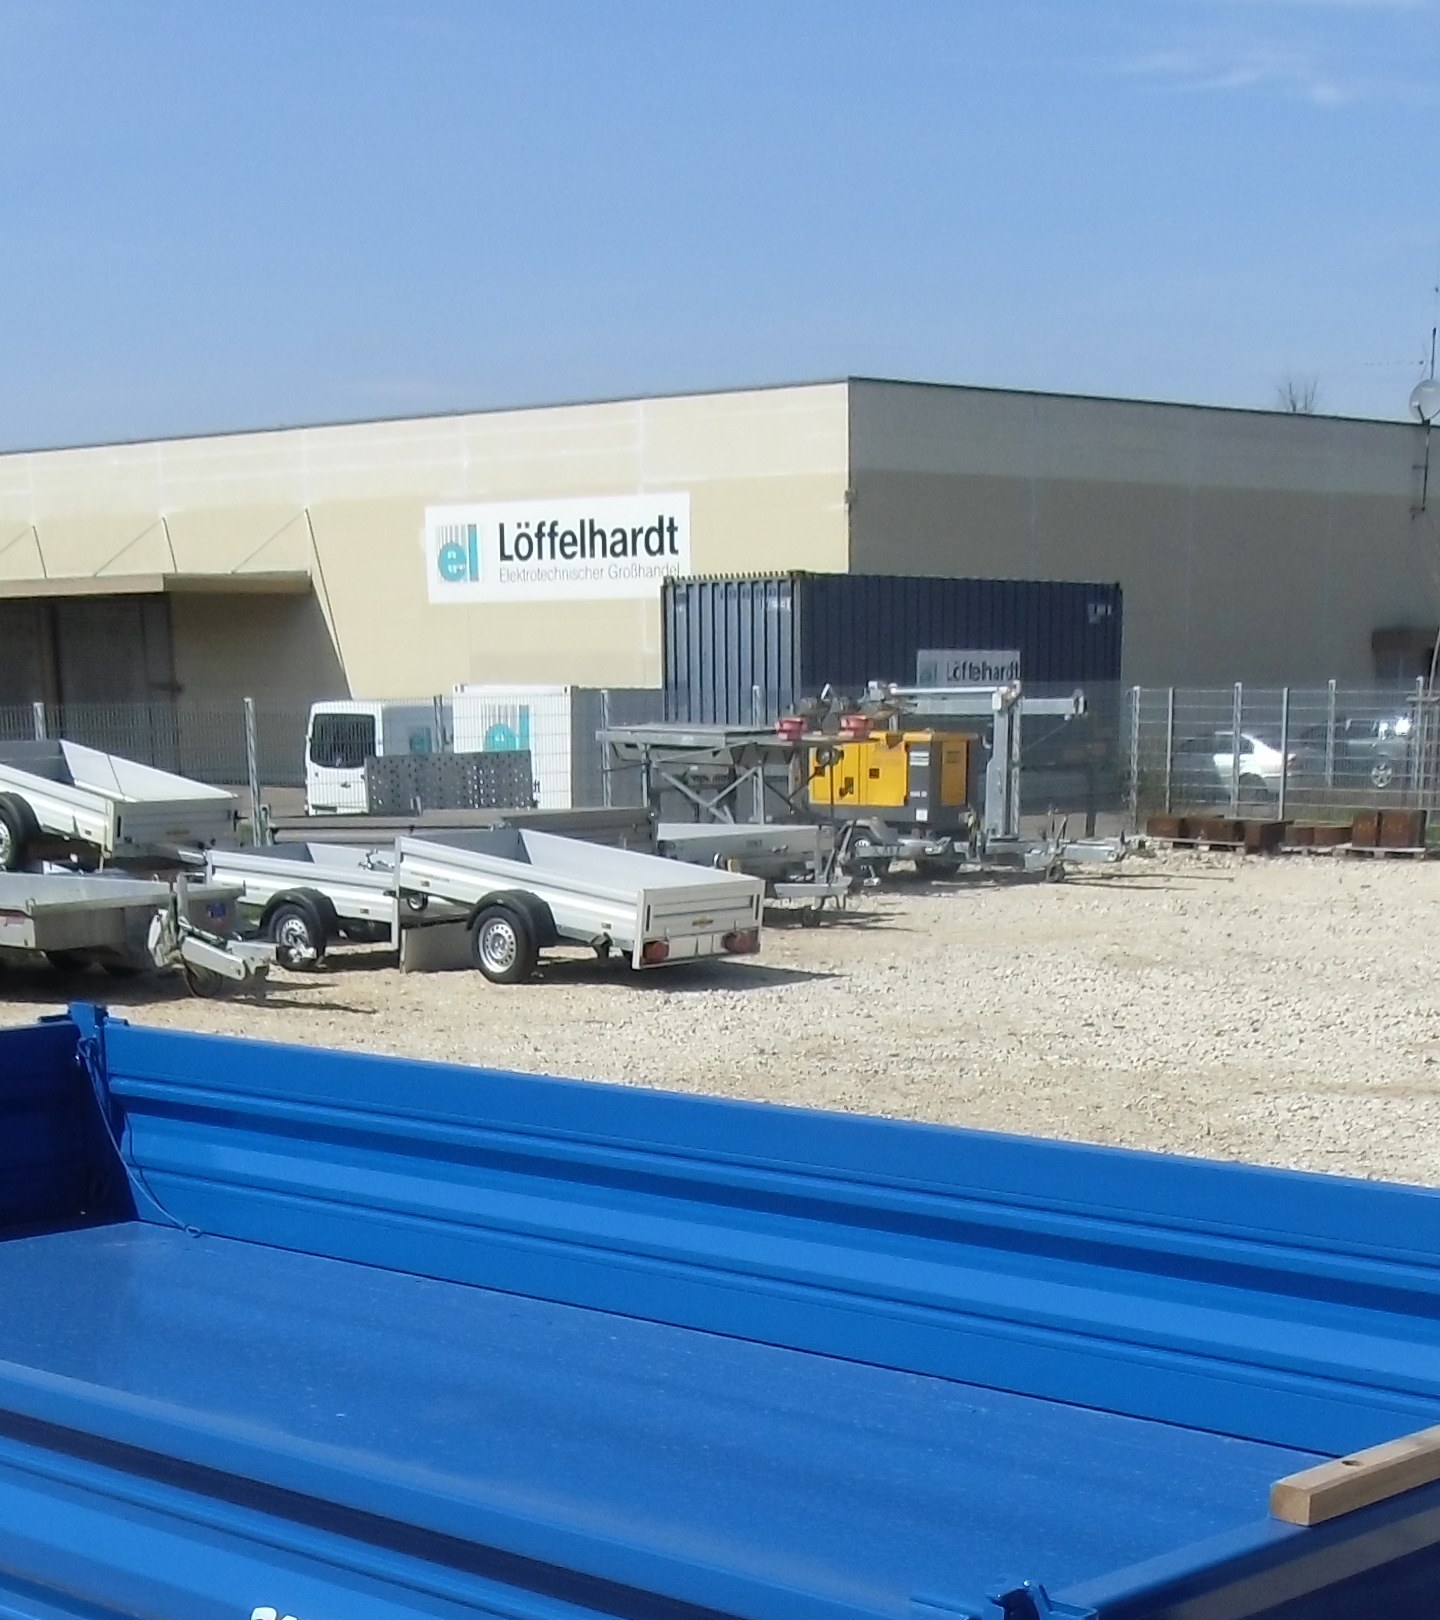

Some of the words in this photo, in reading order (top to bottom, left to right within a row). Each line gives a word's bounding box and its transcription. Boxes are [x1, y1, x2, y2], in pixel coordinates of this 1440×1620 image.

[498, 514, 679, 562] Löffelhardt
[499, 567, 604, 584] Elektrotechnischer
[608, 561, 680, 580] Großhandel
